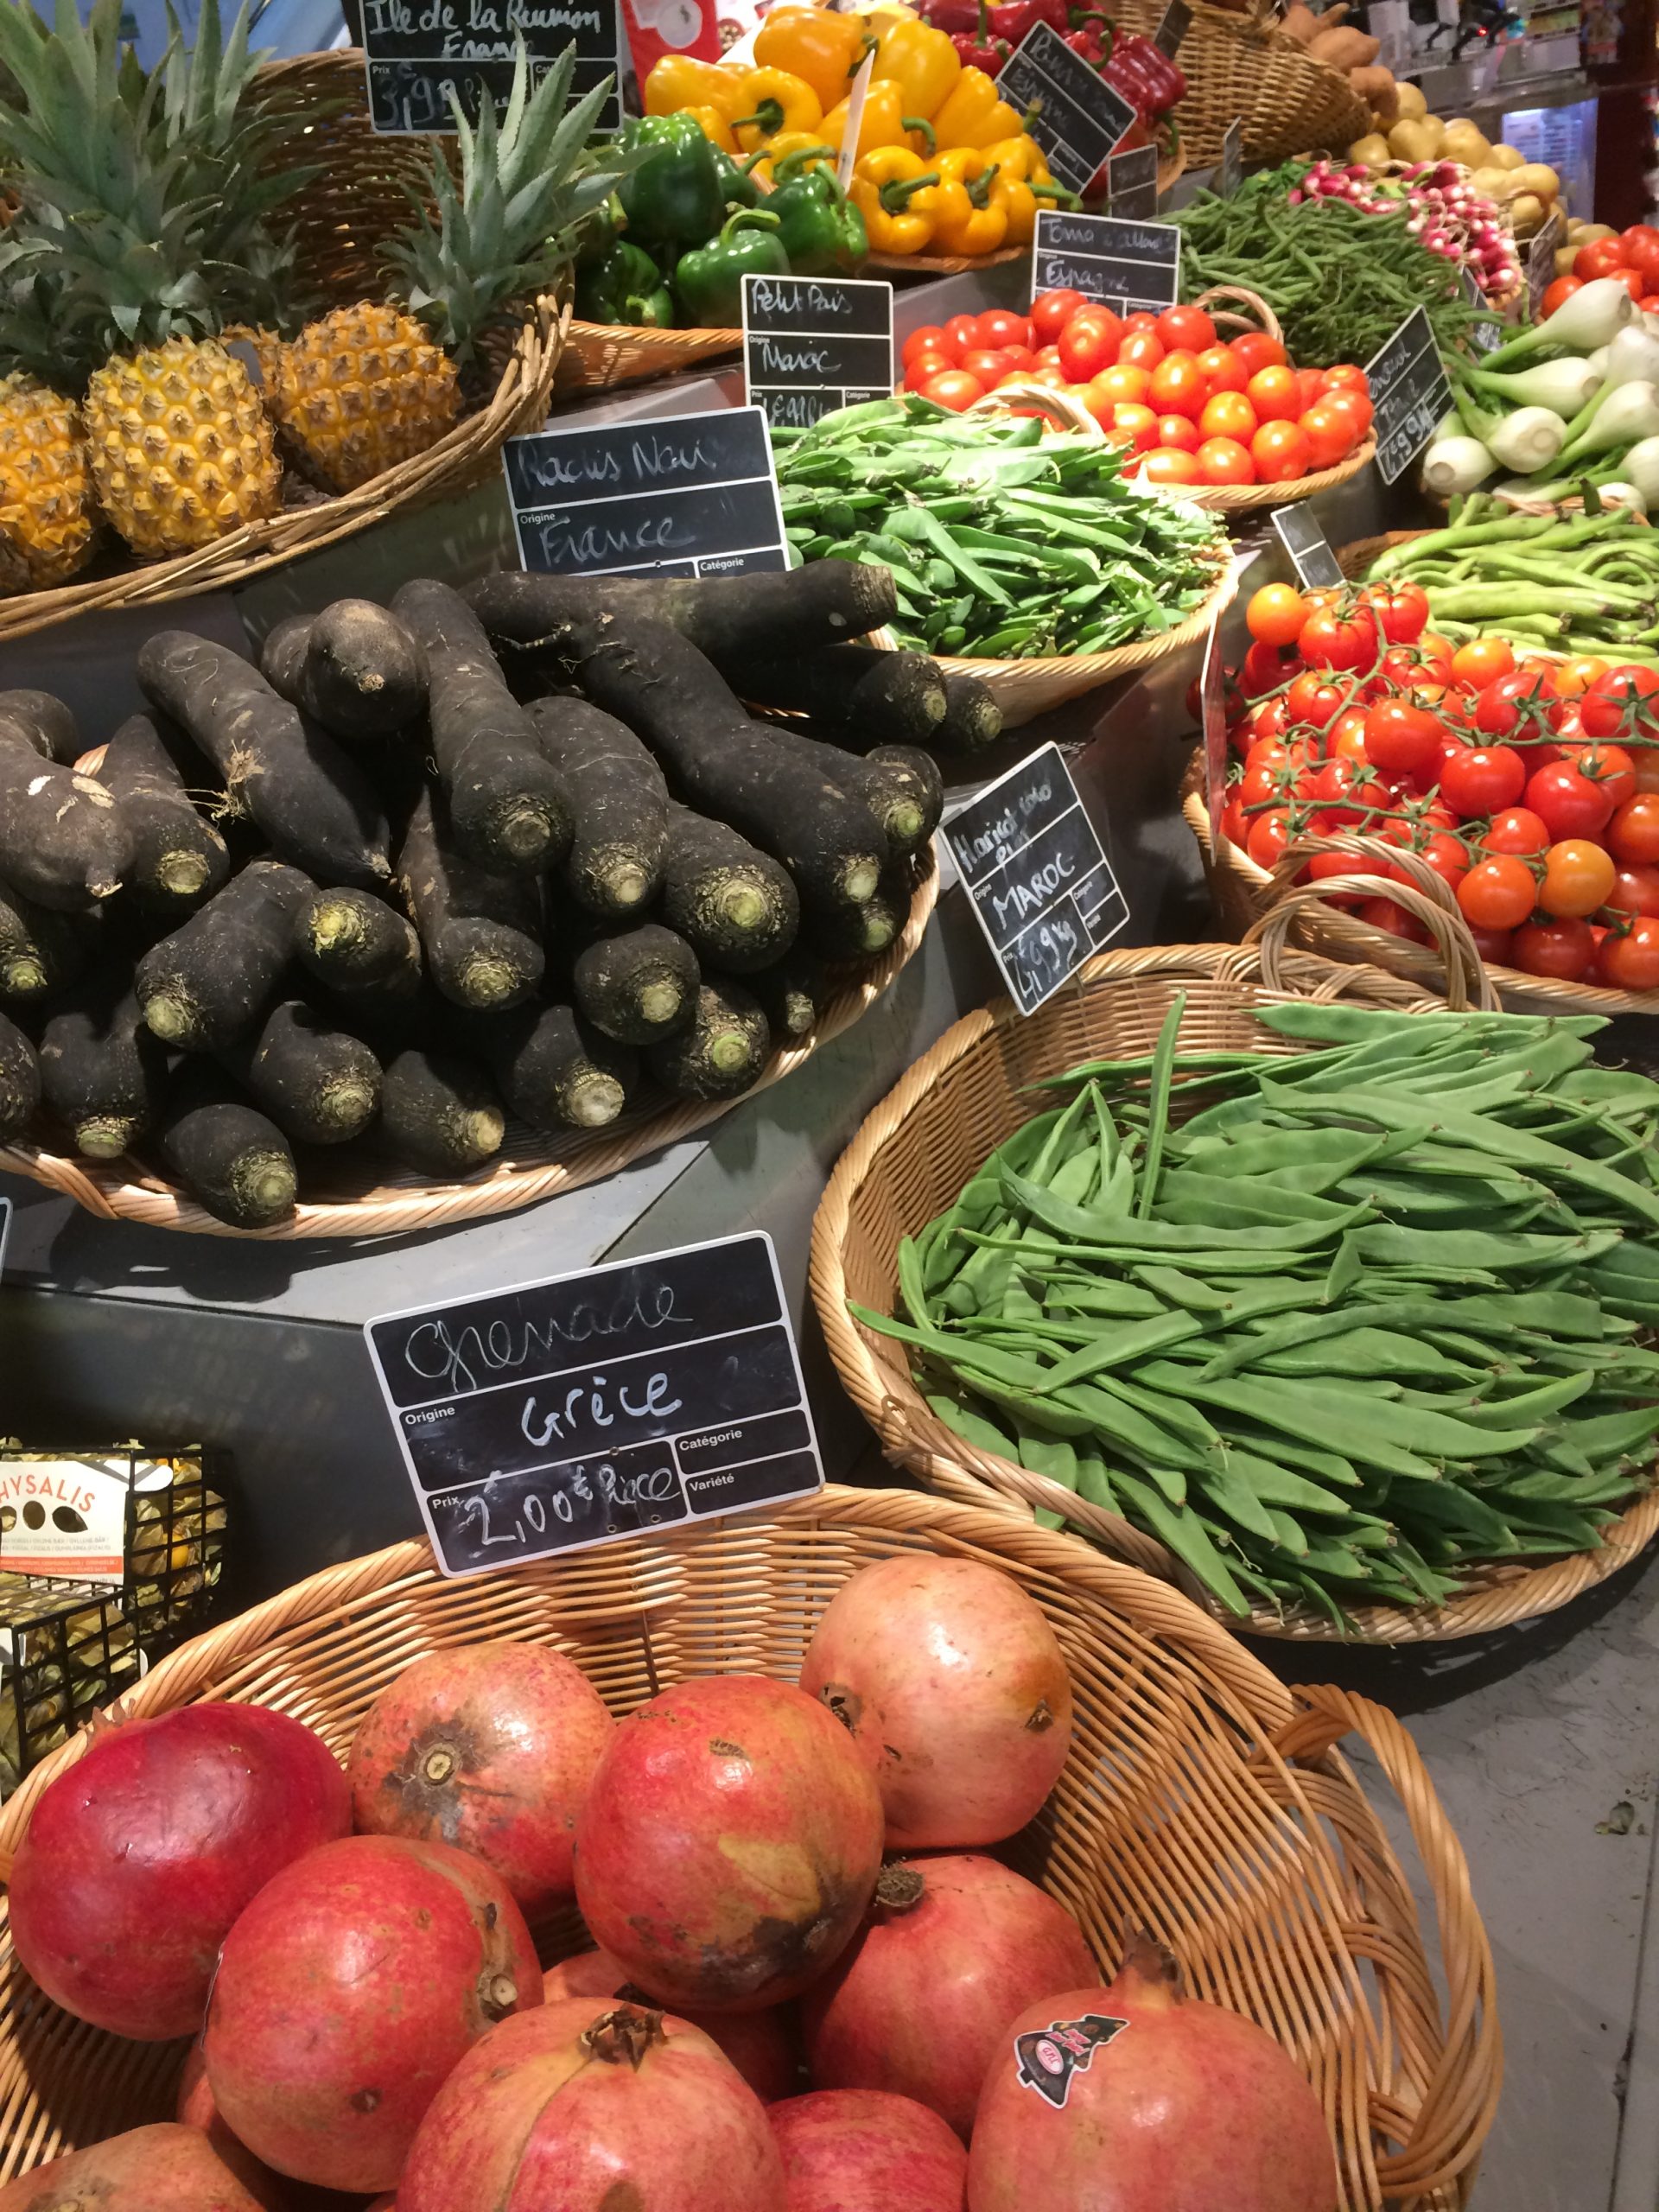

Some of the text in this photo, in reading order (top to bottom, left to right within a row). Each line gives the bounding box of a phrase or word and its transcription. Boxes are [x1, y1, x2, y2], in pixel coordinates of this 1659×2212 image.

[441, 30, 546, 59] Frane
[372, 65, 391, 74] Prix
[763, 344, 842, 373] Maroc
[520, 512, 556, 524] Origine
[539, 516, 696, 567] France
[700, 557, 745, 571] Catégorie
[974, 883, 992, 900] Origine
[993, 852, 1076, 931] MAROC
[404, 1406, 456, 1426] Origine
[521, 1372, 683, 1446] Grèce
[679, 1427, 743, 1452] Catégorie
[690, 1473, 735, 1491] Variété
[432, 1495, 460, 1510] Prix
